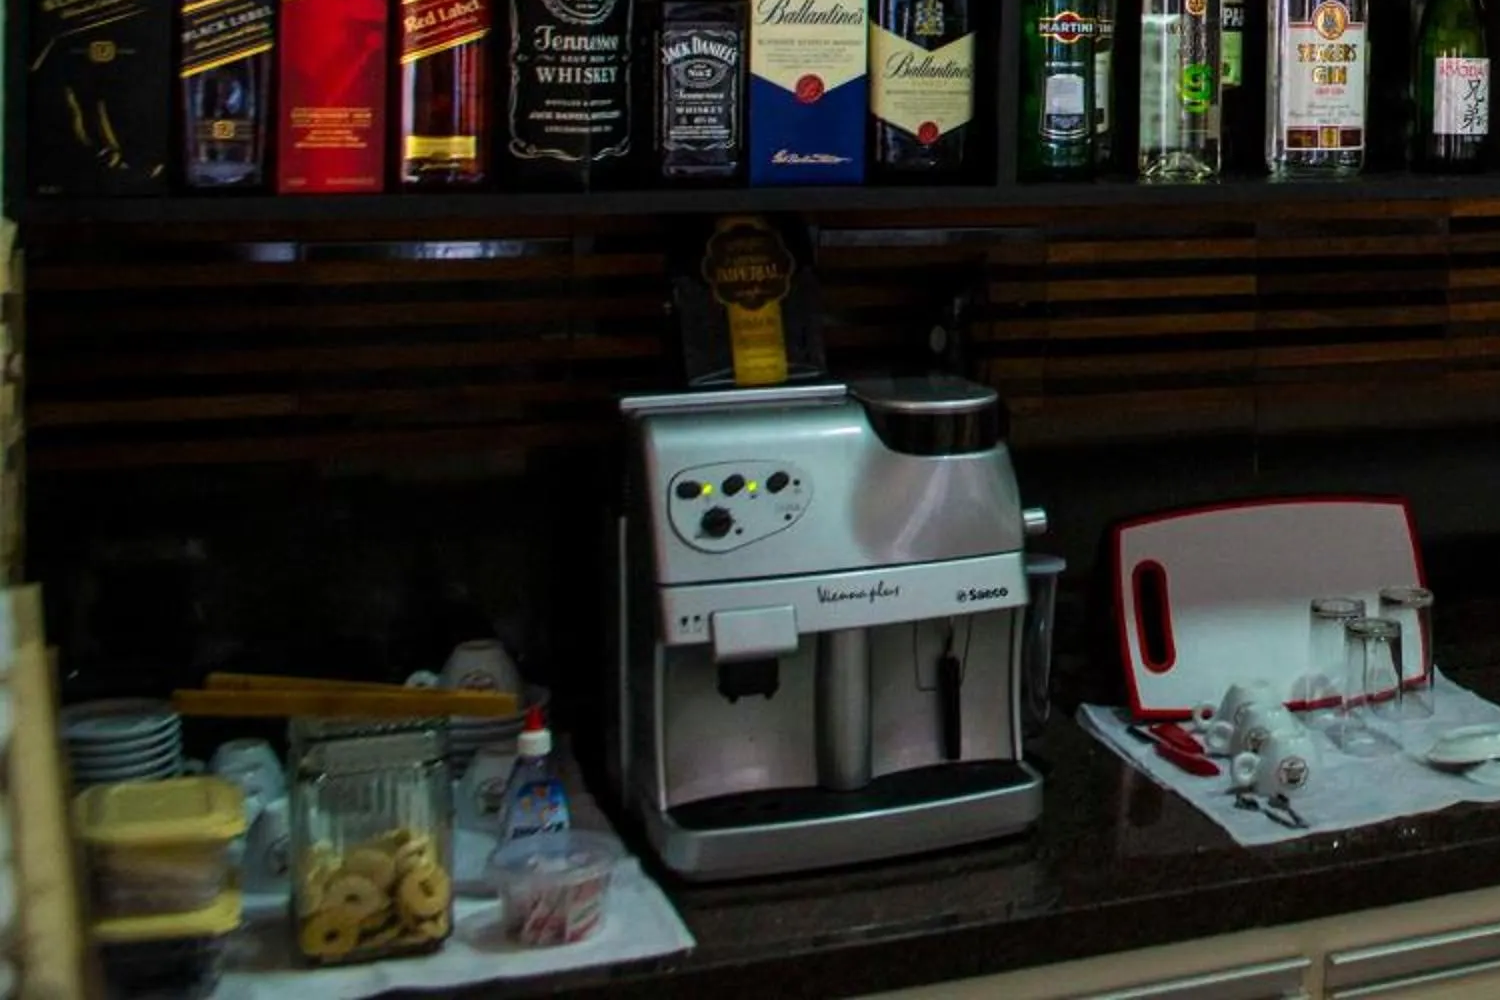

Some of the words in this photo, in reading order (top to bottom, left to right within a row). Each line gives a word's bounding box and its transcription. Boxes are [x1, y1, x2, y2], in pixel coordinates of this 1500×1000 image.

[182, 18, 226, 43] BLACK
[228, 5, 274, 29] LABEL
[404, 10, 437, 33] Red
[1039, 22, 1093, 34] MARTINI
[661, 41, 691, 65] JACK
[536, 66, 619, 85] WHISKEY
[969, 587, 1009, 601] Saeco
